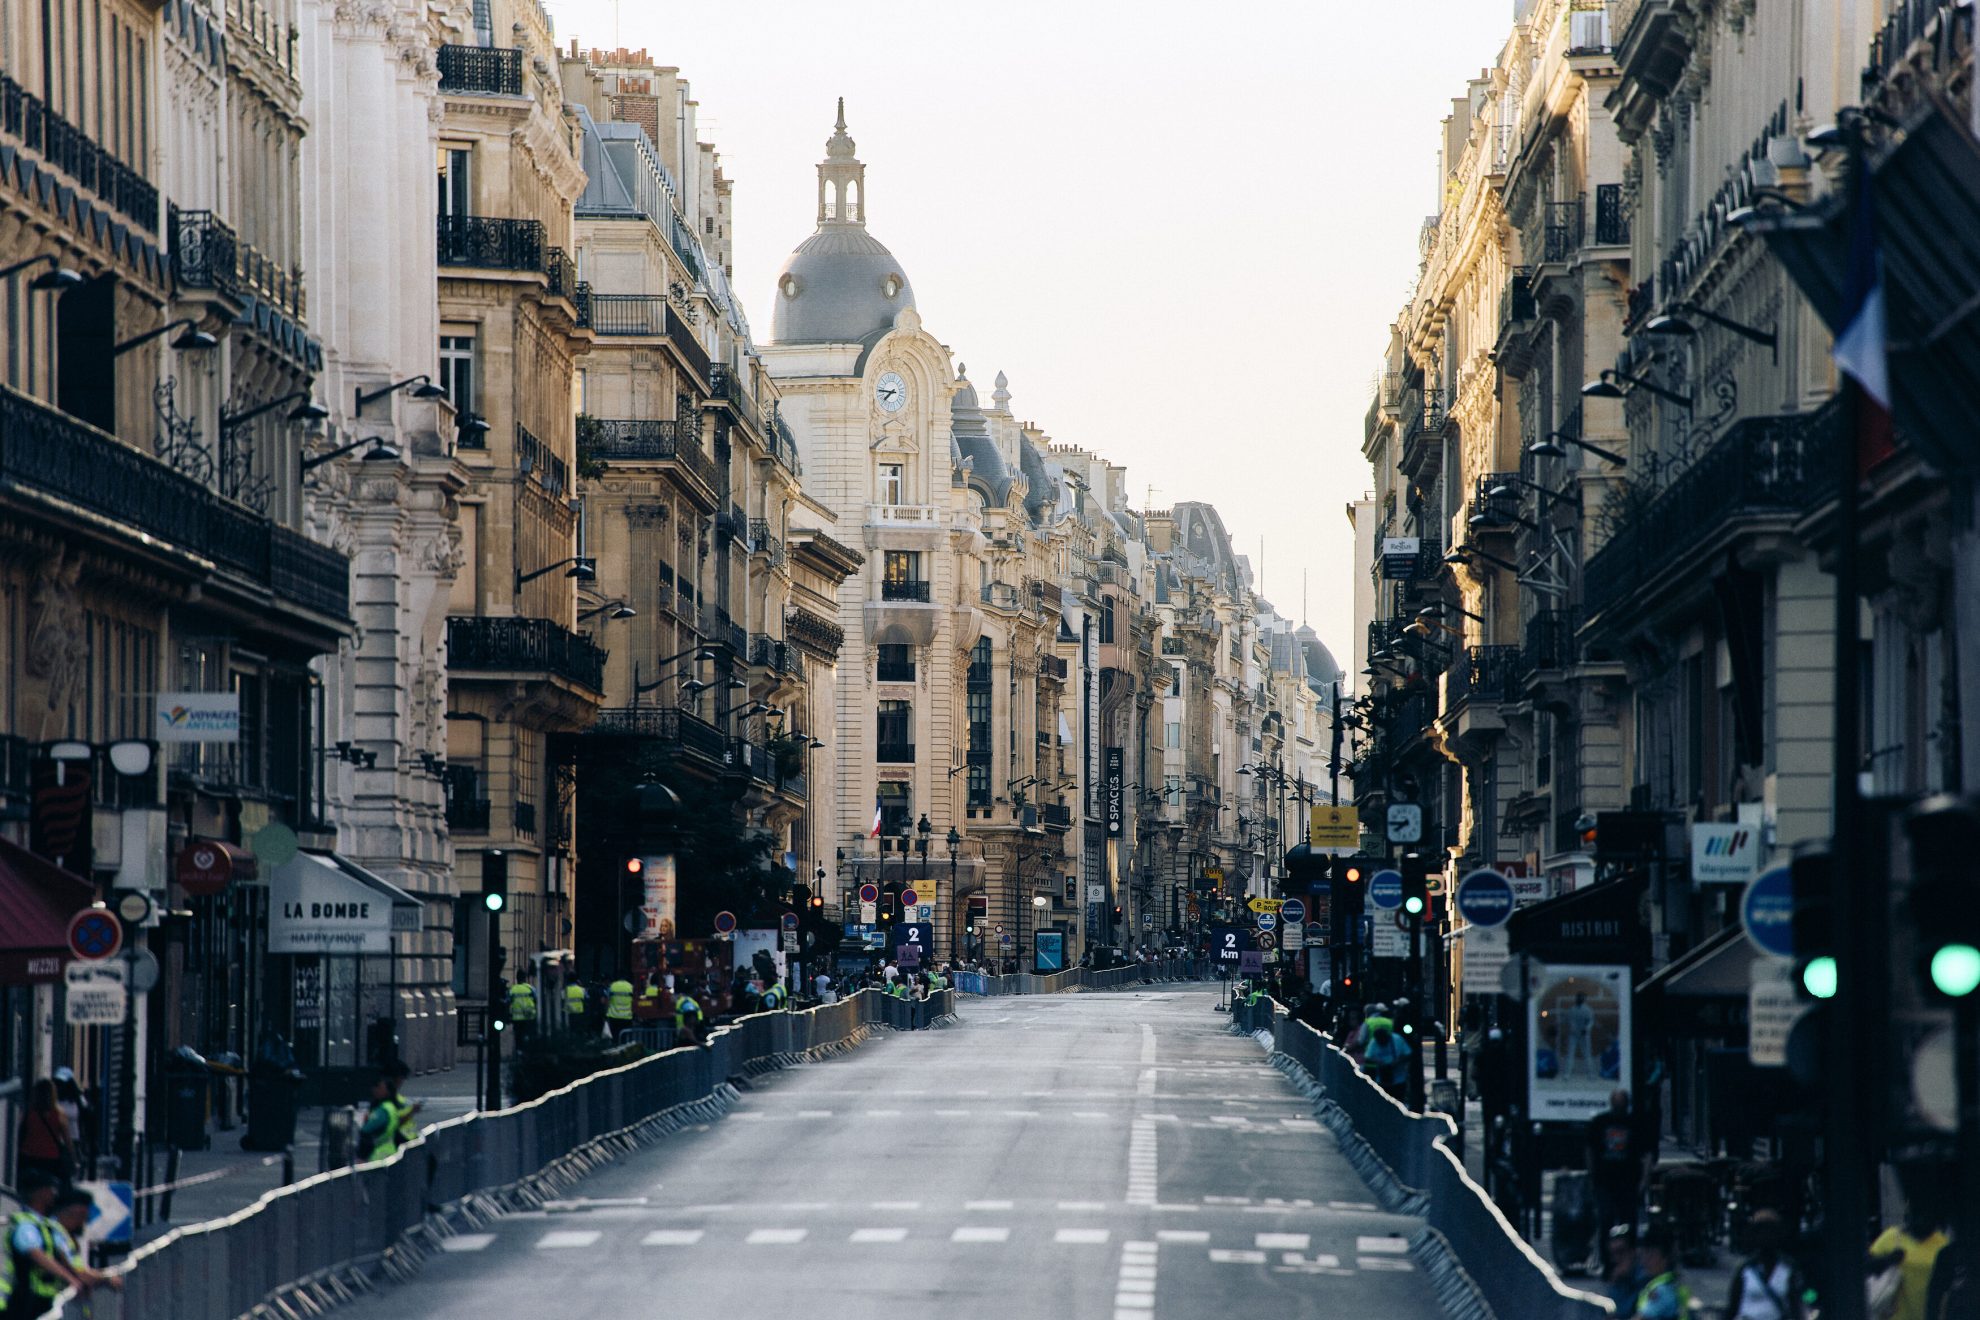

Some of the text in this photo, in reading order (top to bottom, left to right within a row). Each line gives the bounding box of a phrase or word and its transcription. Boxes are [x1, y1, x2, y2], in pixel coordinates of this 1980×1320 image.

[1391, 542, 1411, 551] Regus
[190, 710, 238, 720] VOYAGES
[1701, 863, 1751, 875] Manpower
[284, 902, 370, 918] LA BOMBE
[908, 927, 920, 942] 2
[1225, 933, 1236, 948] 2
[1220, 948, 1239, 959] km
